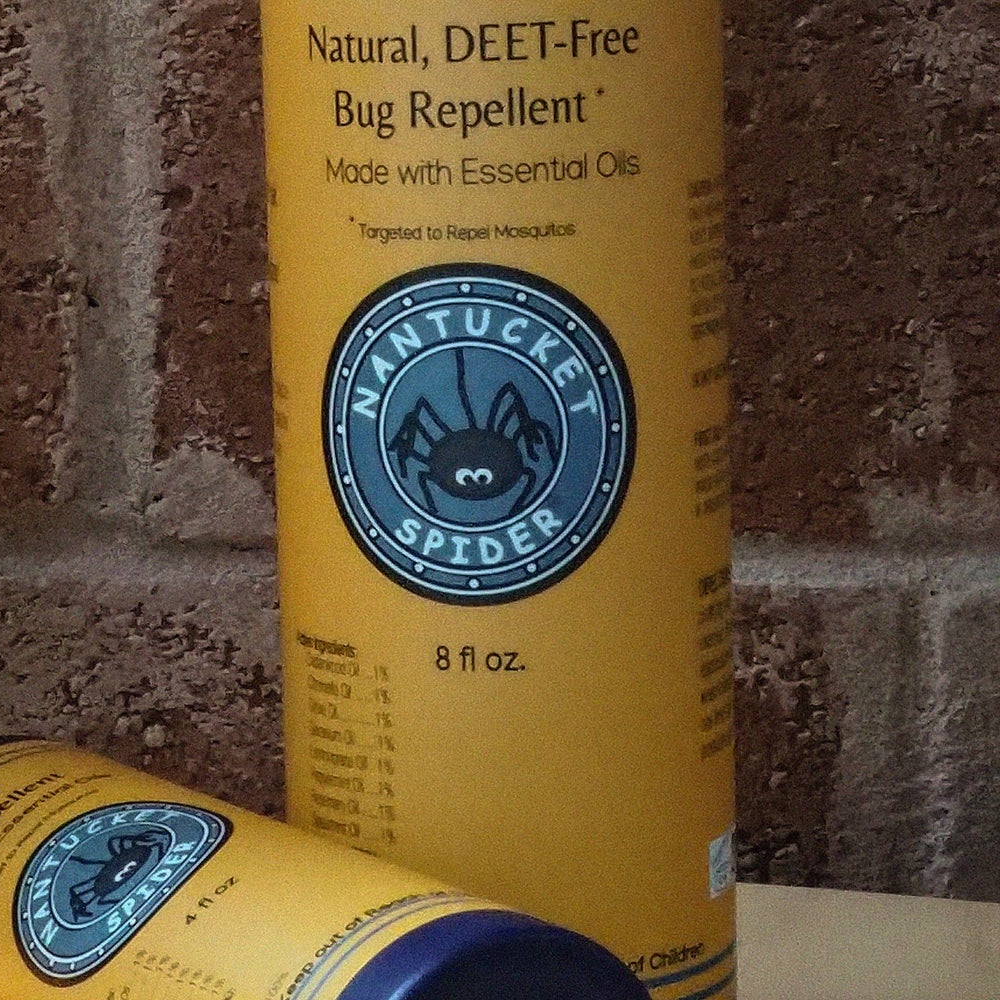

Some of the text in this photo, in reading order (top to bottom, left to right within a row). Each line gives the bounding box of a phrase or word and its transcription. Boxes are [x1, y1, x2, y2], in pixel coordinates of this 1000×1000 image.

[308, 19, 639, 69] Natural, DEET-Free
[334, 90, 394, 139] Bug
[325, 151, 641, 186] Made with Essential Oils
[427, 225, 443, 241] to
[447, 224, 490, 241] Repel
[352, 308, 597, 420] NANTUCKET
[394, 508, 563, 565] SPIDER
[436, 645, 526, 672] 8 fl oz.
[38, 807, 181, 946] NANTUCKET
[106, 840, 197, 935] SPIDER
[185, 911, 198, 926] 4
[214, 876, 238, 895] oz
[315, 931, 345, 958] out
